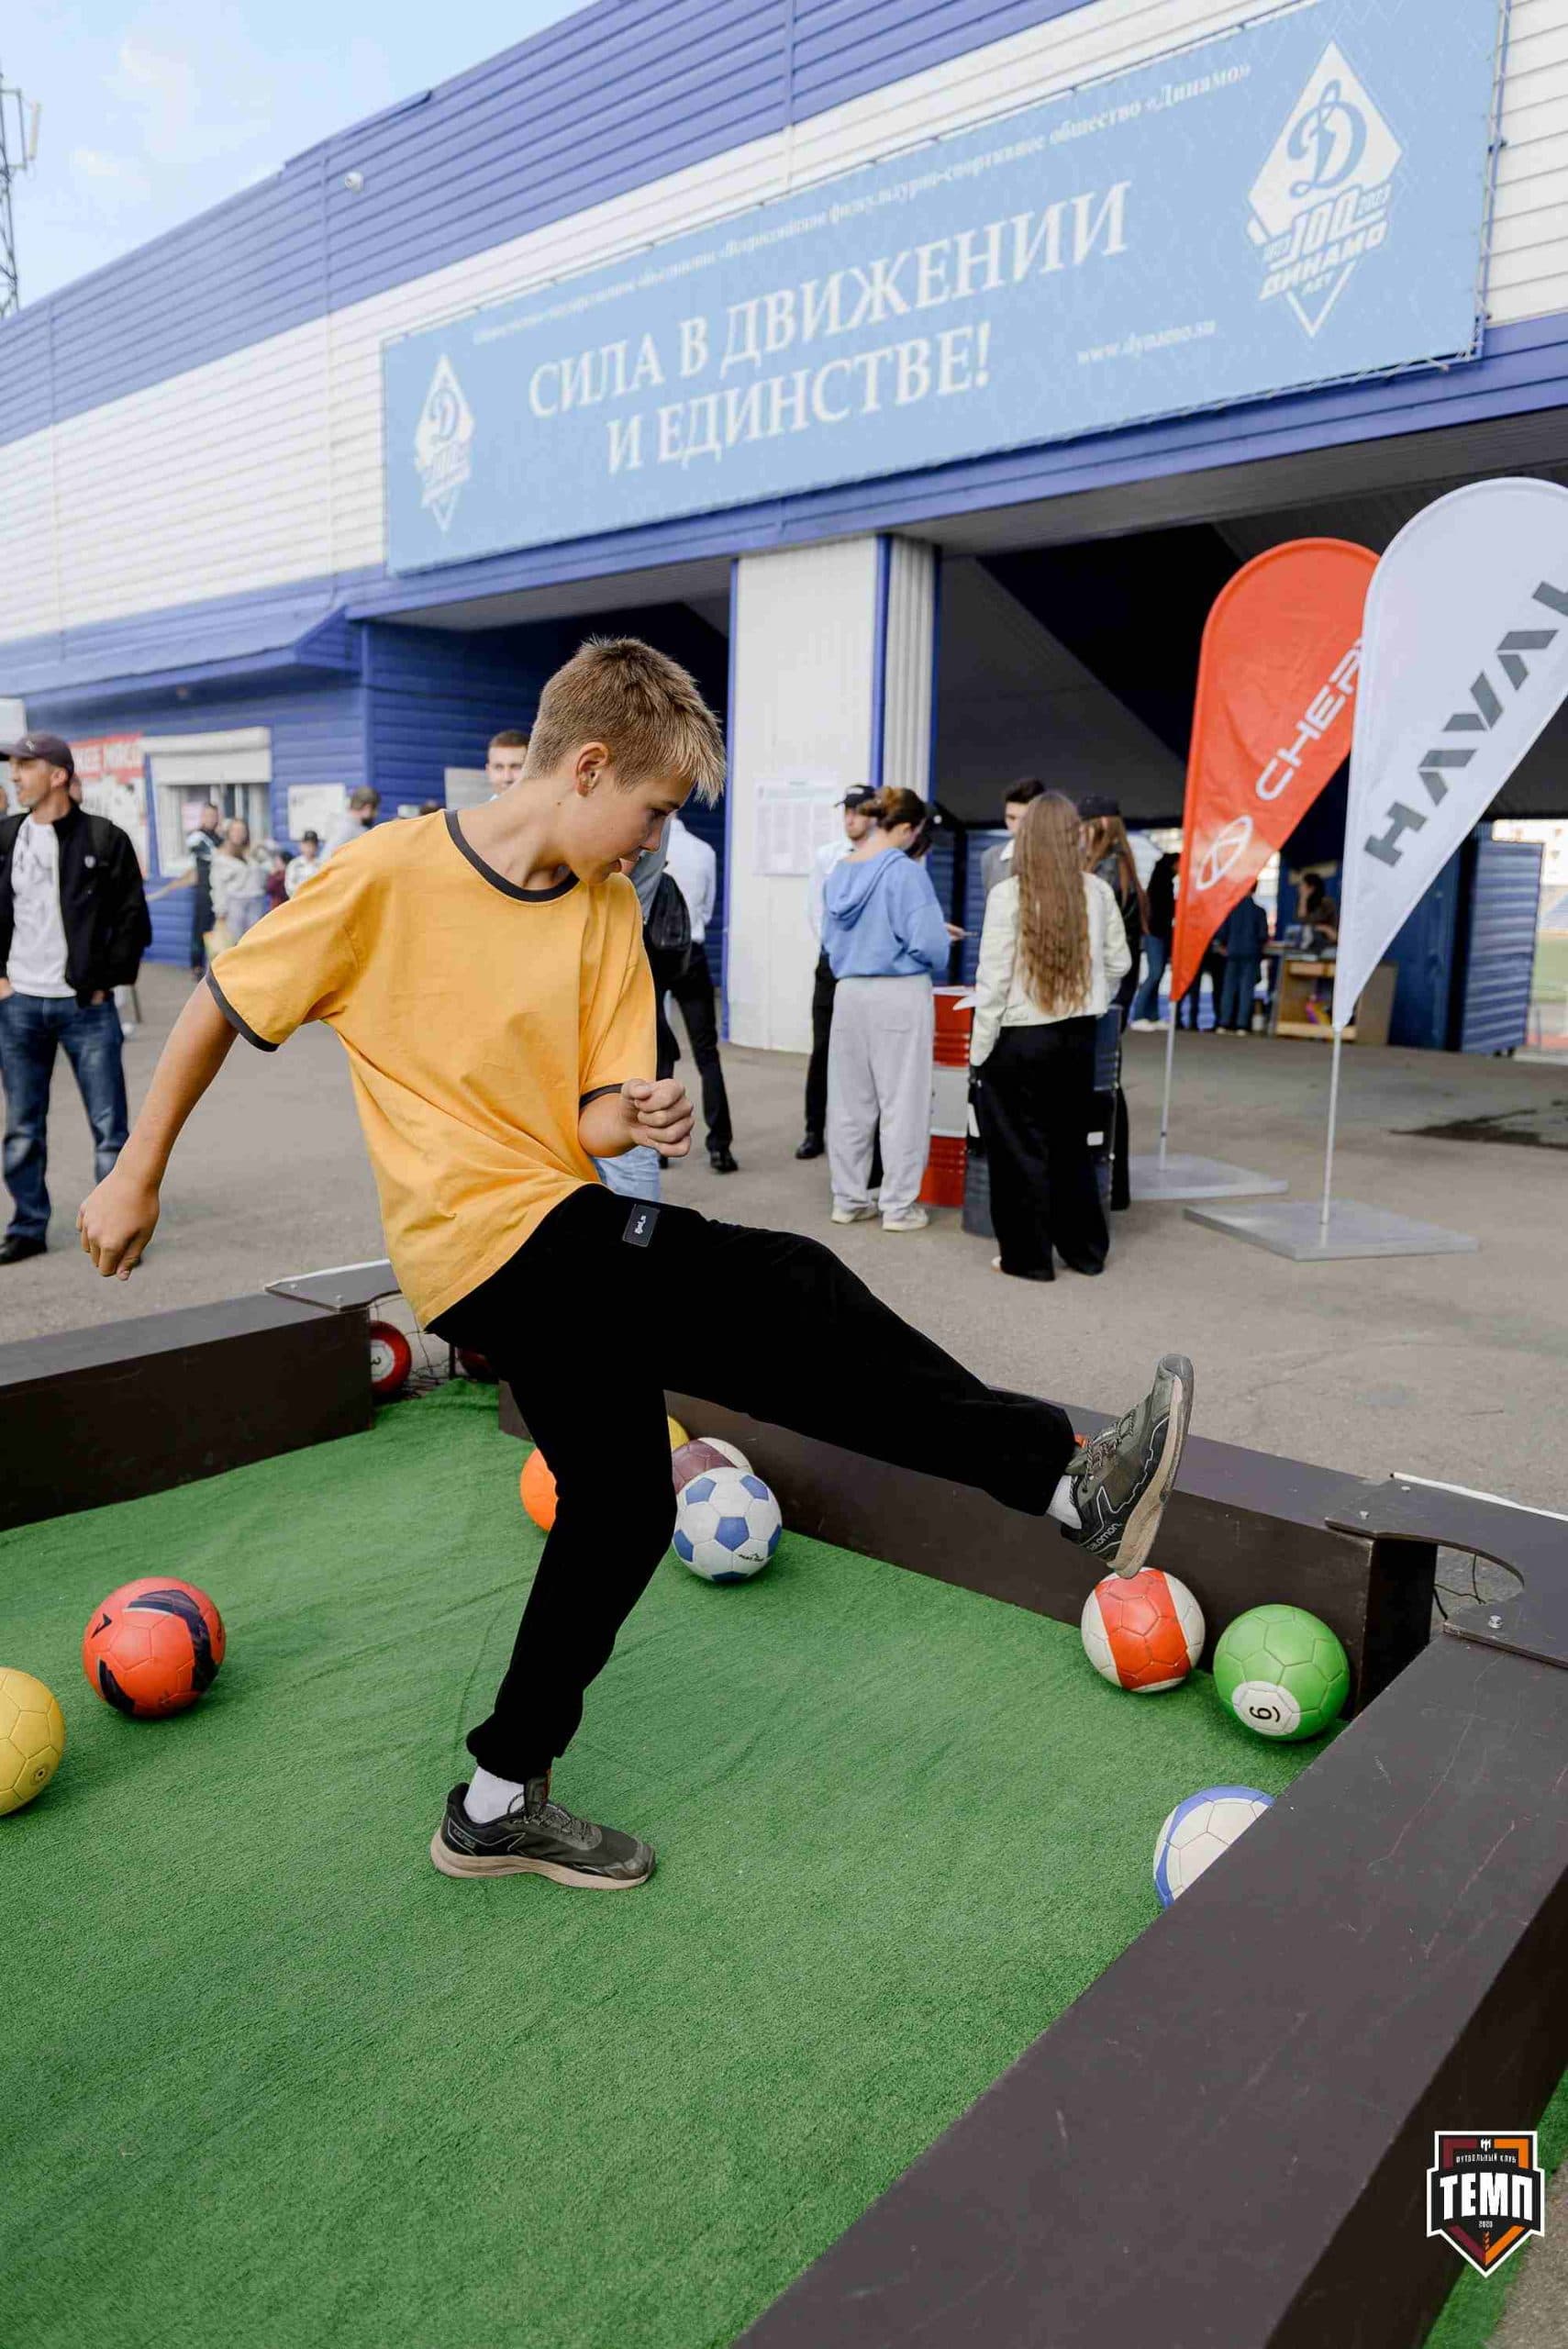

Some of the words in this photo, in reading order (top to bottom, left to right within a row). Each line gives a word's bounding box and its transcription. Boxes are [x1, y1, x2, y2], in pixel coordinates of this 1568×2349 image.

[1145, 62, 1251, 113] «Динамо»
[528, 336, 664, 417] СИЛА
[678, 319, 709, 378] В
[718, 181, 1130, 377] ДВИЖЕНИИ
[1259, 221, 1388, 301] ДИНАМО
[607, 419, 642, 474] И
[654, 323, 992, 470] ЕДИНСТВЕ!
[1255, 638, 1362, 801] CHER
